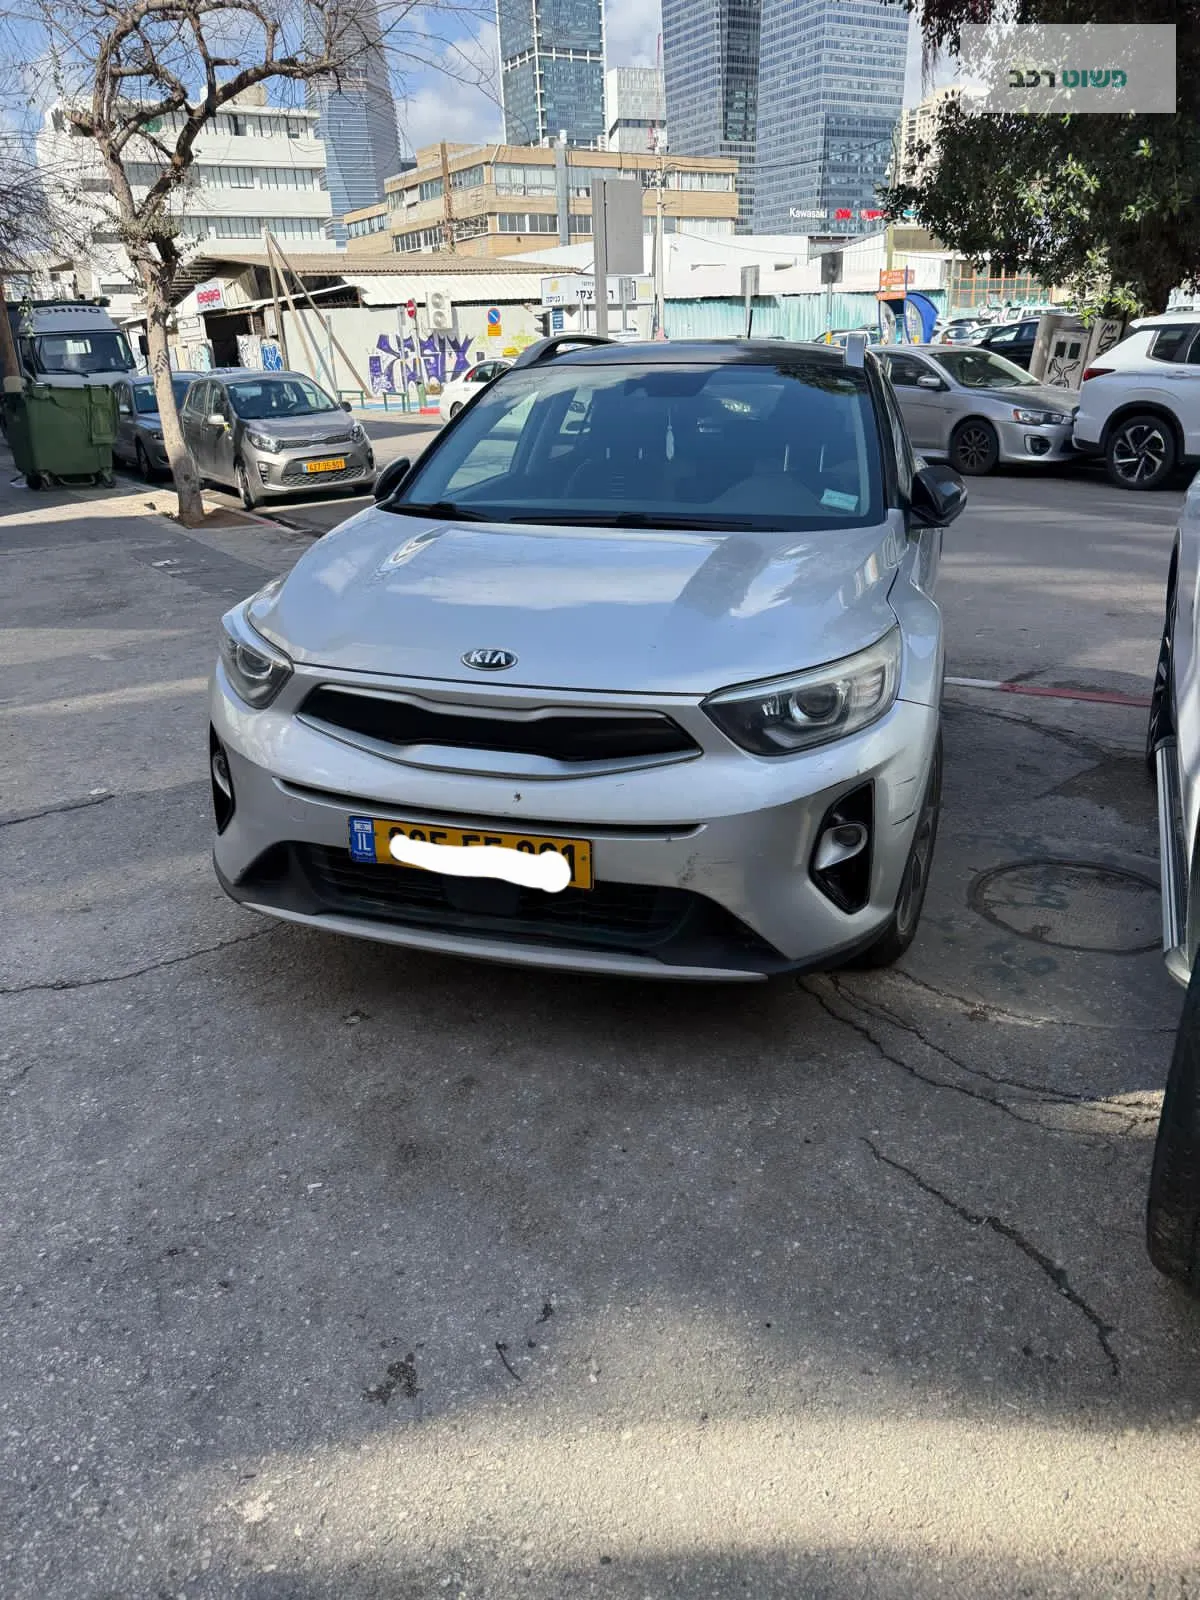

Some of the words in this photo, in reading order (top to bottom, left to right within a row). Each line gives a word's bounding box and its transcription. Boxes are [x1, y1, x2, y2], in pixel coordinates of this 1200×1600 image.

[789, 207, 828, 218] Kawasaki
[470, 650, 506, 665] KIA
[358, 832, 371, 850] IL
